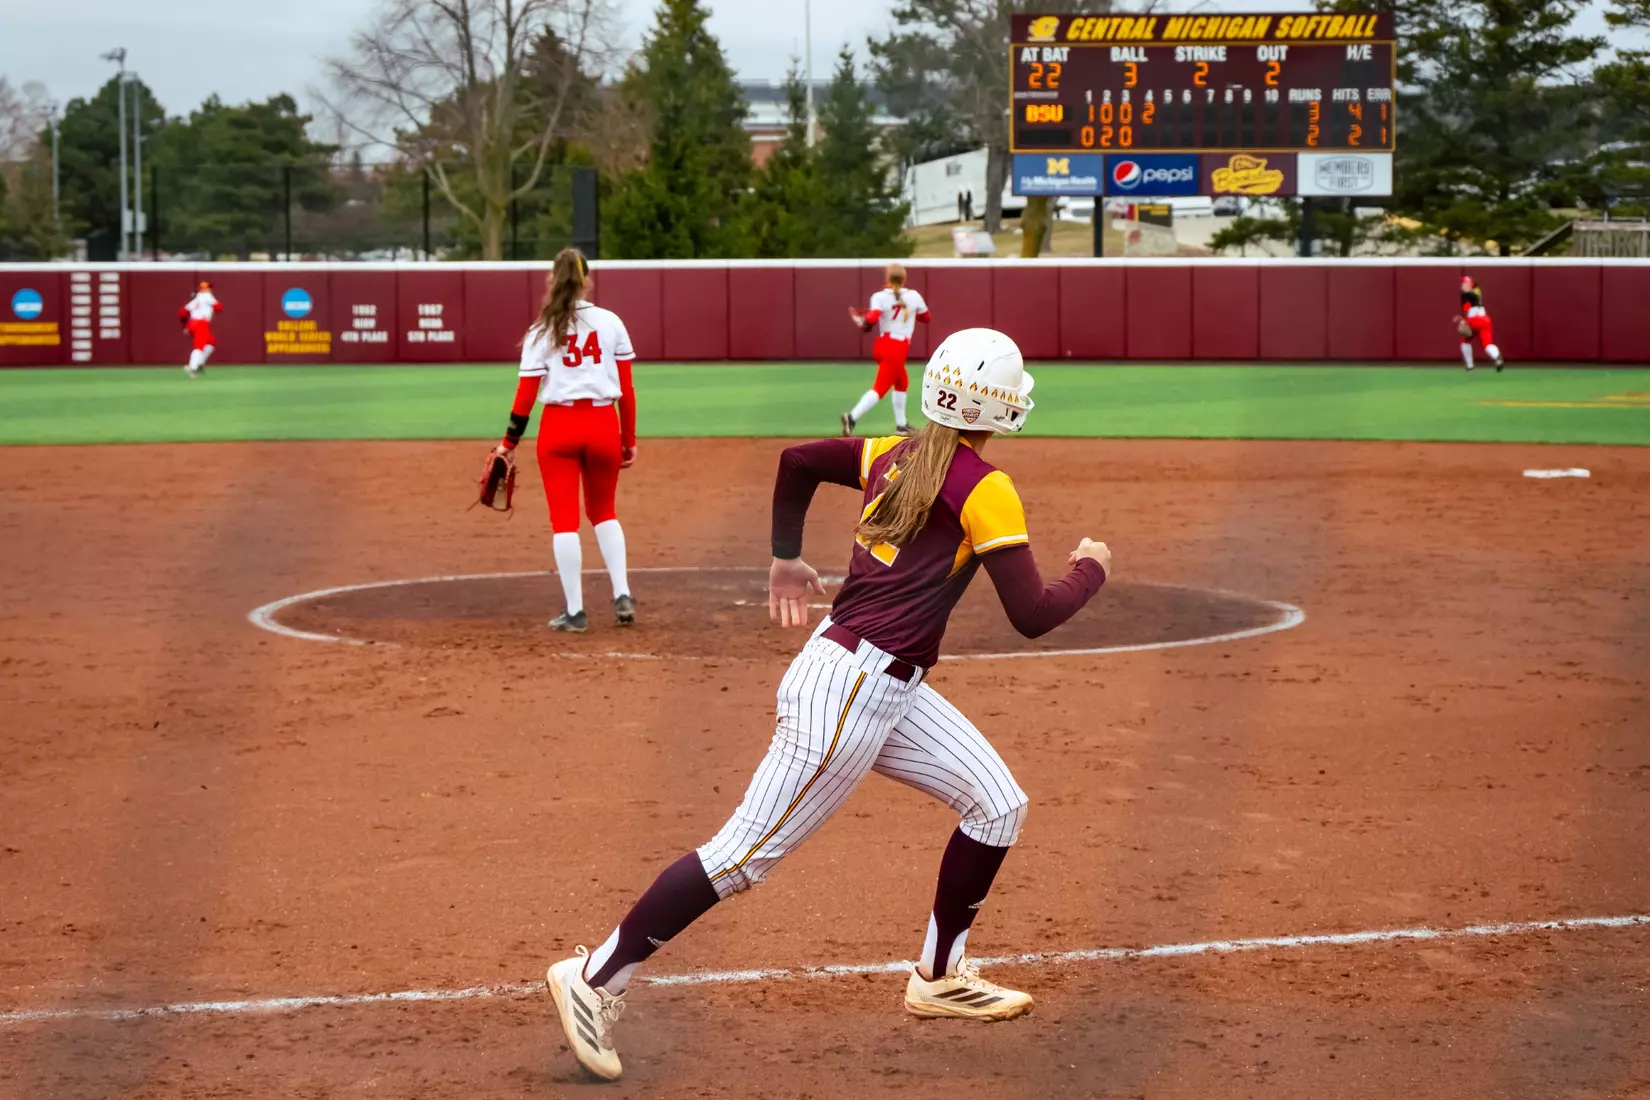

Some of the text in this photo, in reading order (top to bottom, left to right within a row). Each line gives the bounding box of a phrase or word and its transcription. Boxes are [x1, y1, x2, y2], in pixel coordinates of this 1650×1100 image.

[1066, 15, 1378, 40] CENTRAL MICHIGAN SOFTBALL
[1021, 47, 1070, 62] AT BAT
[1110, 46, 1148, 62] BALL
[1175, 46, 1227, 61] STRIKE
[1257, 45, 1288, 61] OUT
[1346, 44, 1372, 60] H/E
[1028, 62, 1061, 89] 22
[1124, 62, 1138, 88] 3
[1193, 62, 1208, 87] 2
[1264, 61, 1281, 86] 2
[1085, 88, 1391, 103] 1 2 3 4 5 6 7 8 9 10 RUNS HITS ERR
[1100, 102, 1113, 124] 0
[1119, 102, 1132, 124] 0
[1142, 102, 1155, 124] 2
[1308, 101, 1320, 122] 3
[1347, 102, 1362, 121] 4
[1081, 125, 1094, 148] 0
[1100, 125, 1113, 147] 2
[1119, 125, 1132, 148] 0
[1306, 124, 1320, 147] 2
[1347, 124, 1362, 146] 2
[1047, 158, 1070, 175] M
[1143, 166, 1194, 183] pepsi
[892, 304, 904, 320] 7
[561, 331, 602, 367] 34
[937, 389, 958, 411] 22
